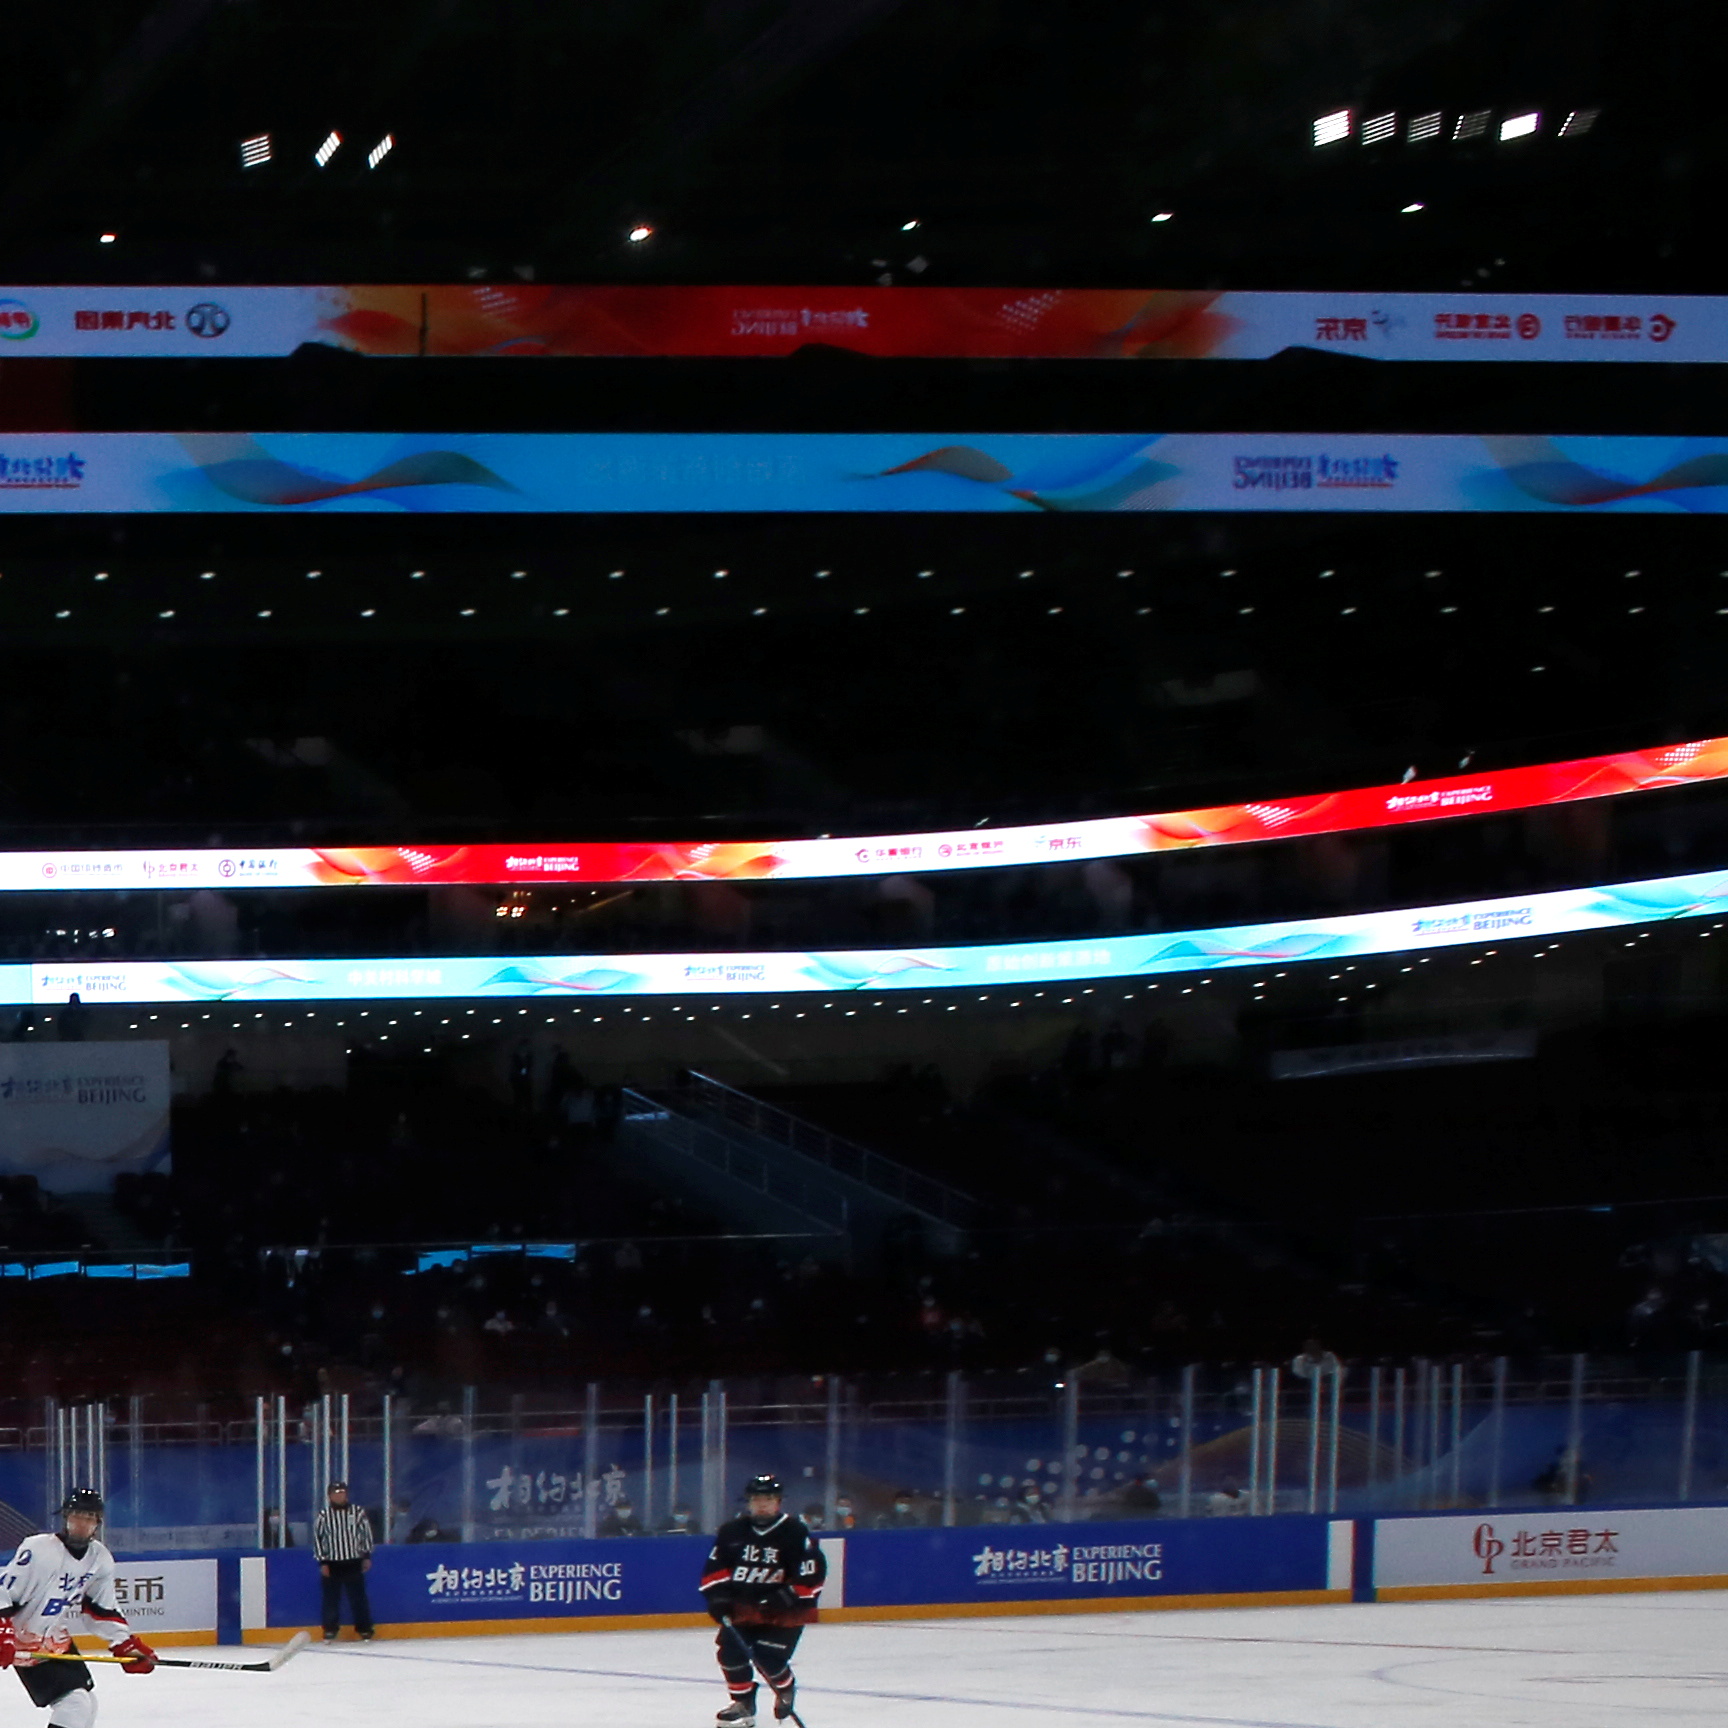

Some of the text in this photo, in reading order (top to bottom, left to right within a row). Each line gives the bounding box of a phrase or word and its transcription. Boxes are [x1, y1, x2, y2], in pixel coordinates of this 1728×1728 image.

[77, 1088, 147, 1103] BEIJING
[1073, 1544, 1162, 1560] EXPERIENCE
[1511, 1529, 1620, 1557] 北京君太
[742, 1545, 779, 1563] 北京
[972, 1544, 1070, 1576] 相约北京
[426, 1562, 526, 1595] 相约北京
[530, 1563, 622, 1580] EXPERIENCE
[733, 1566, 784, 1583] BHA
[1073, 1560, 1162, 1584] BEIJING
[529, 1579, 622, 1603] BEIJING
